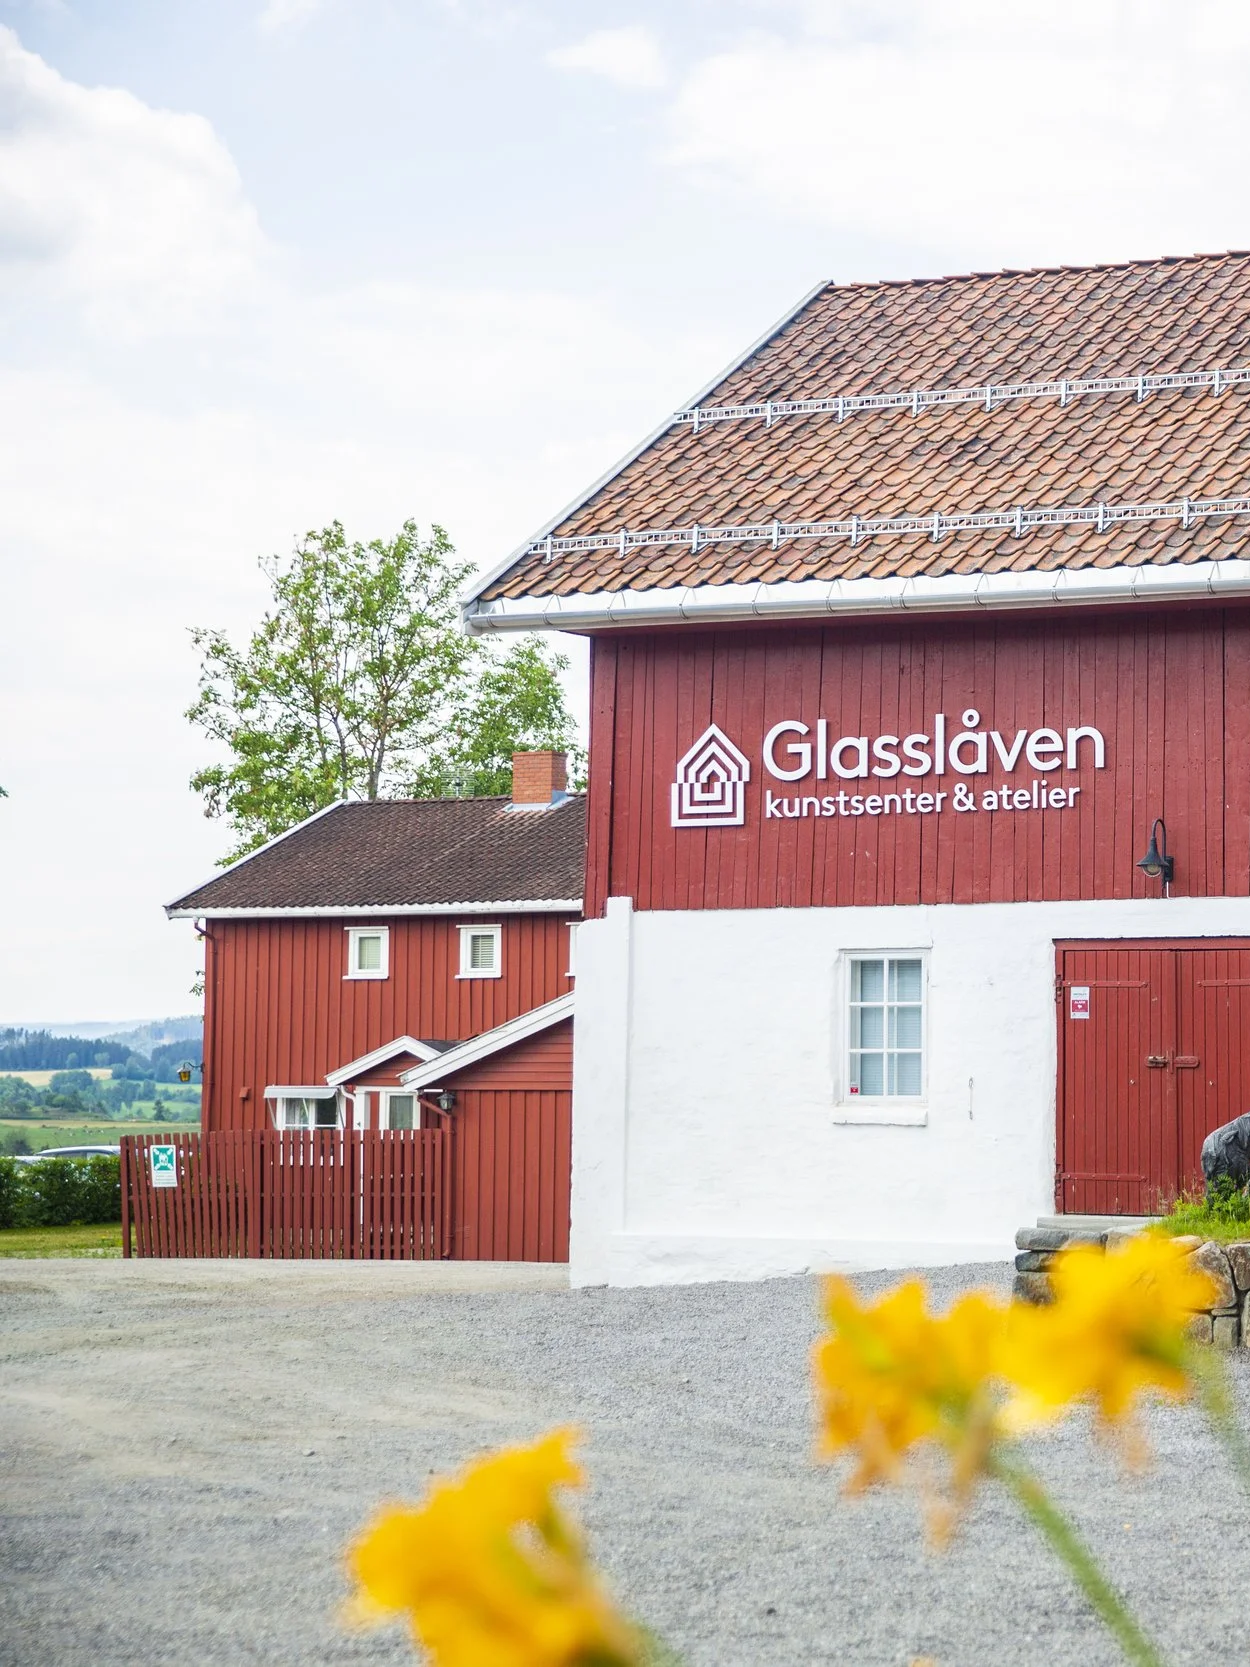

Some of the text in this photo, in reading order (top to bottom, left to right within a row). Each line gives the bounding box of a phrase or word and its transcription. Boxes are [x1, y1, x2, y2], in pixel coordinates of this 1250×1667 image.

[763, 708, 1105, 781] Glasslåven
[765, 779, 1081, 819] kunstsenter & atelier
